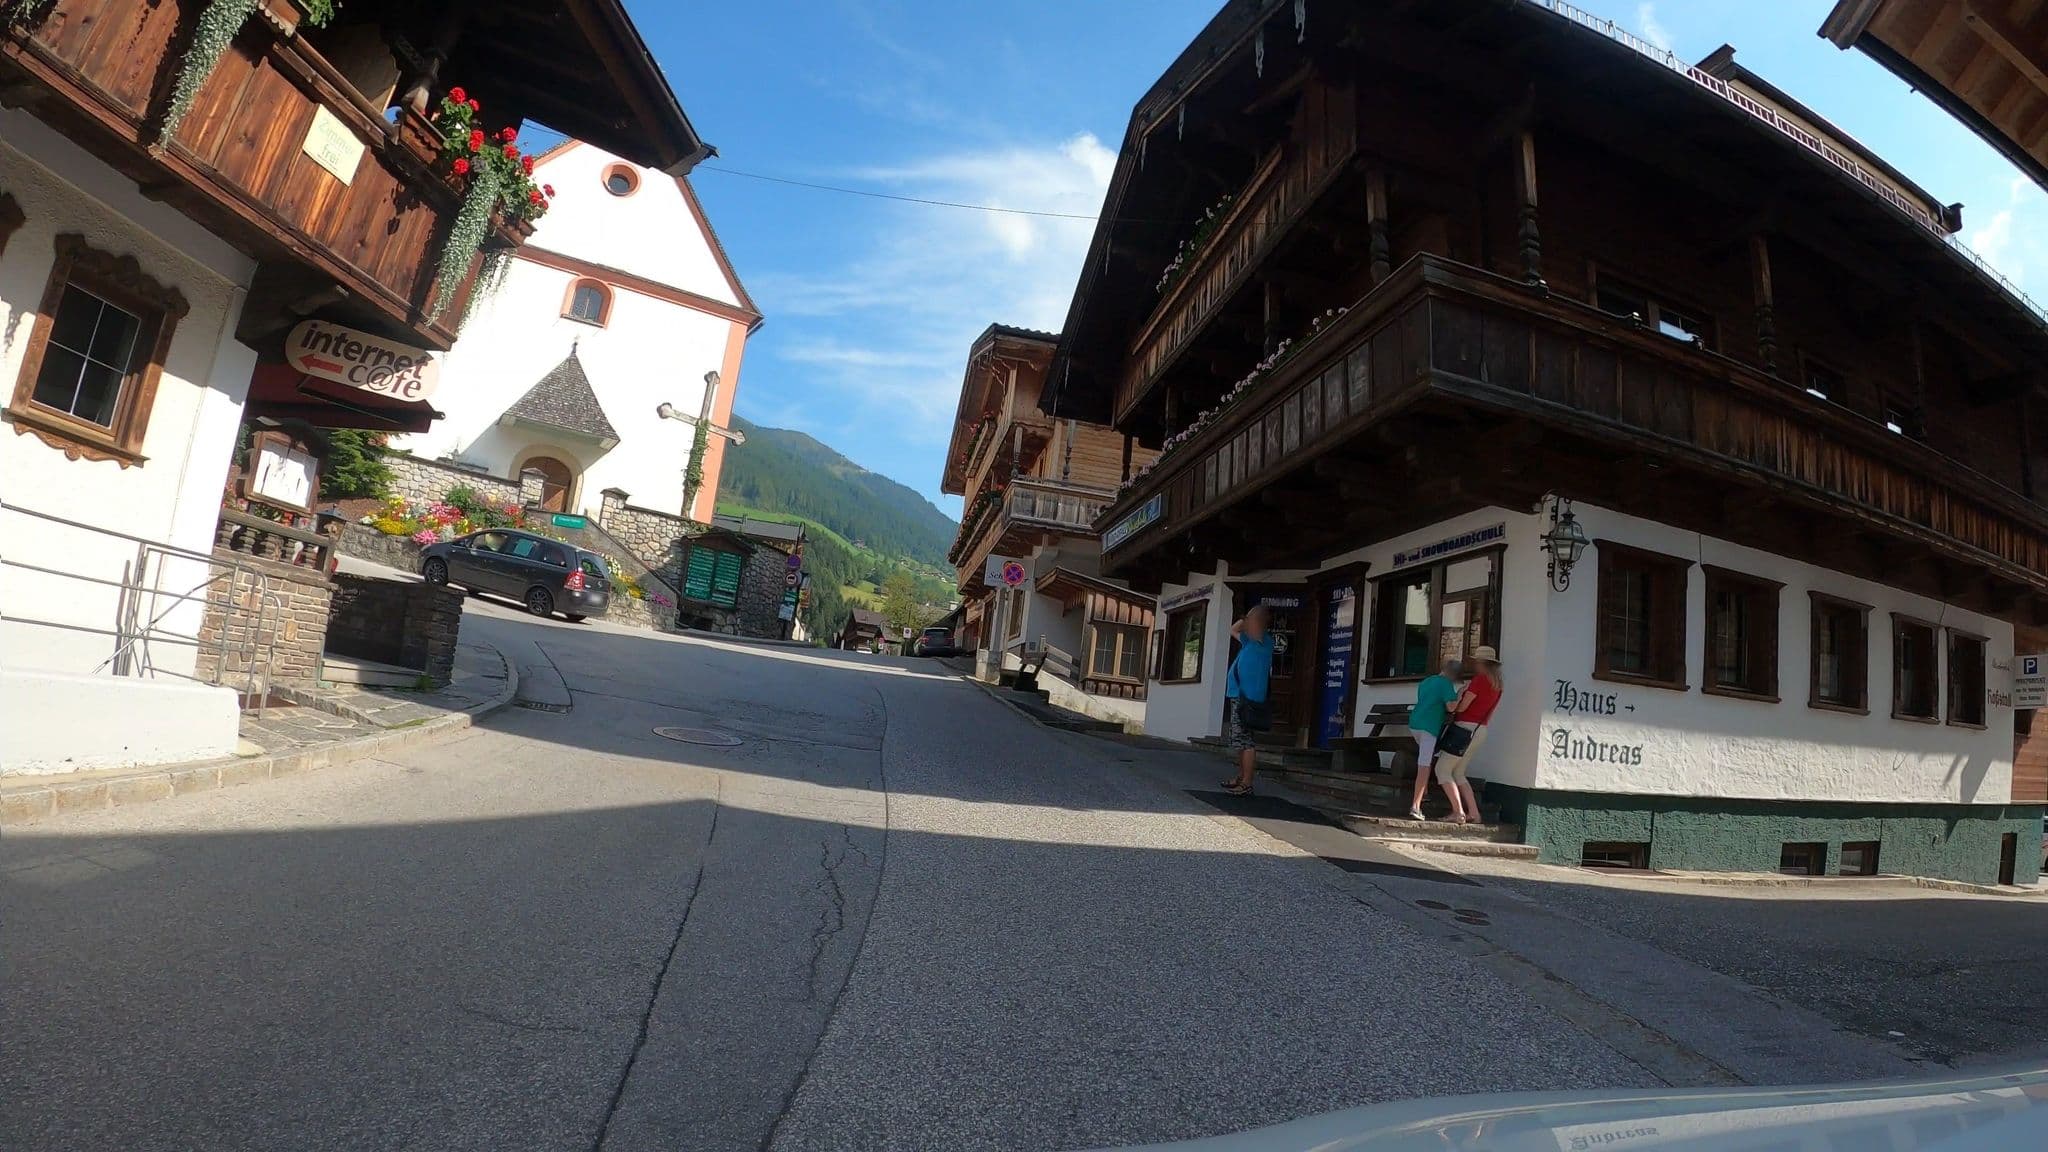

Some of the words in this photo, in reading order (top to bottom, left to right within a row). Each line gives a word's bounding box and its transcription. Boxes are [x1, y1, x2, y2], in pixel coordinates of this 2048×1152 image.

[301, 323, 429, 379] internet
[1421, 526, 1504, 559] SNOWBOARDSCHULE
[2026, 659, 2036, 673] P
[1554, 679, 1618, 716] Haus
[1550, 728, 1643, 766] Andreas
